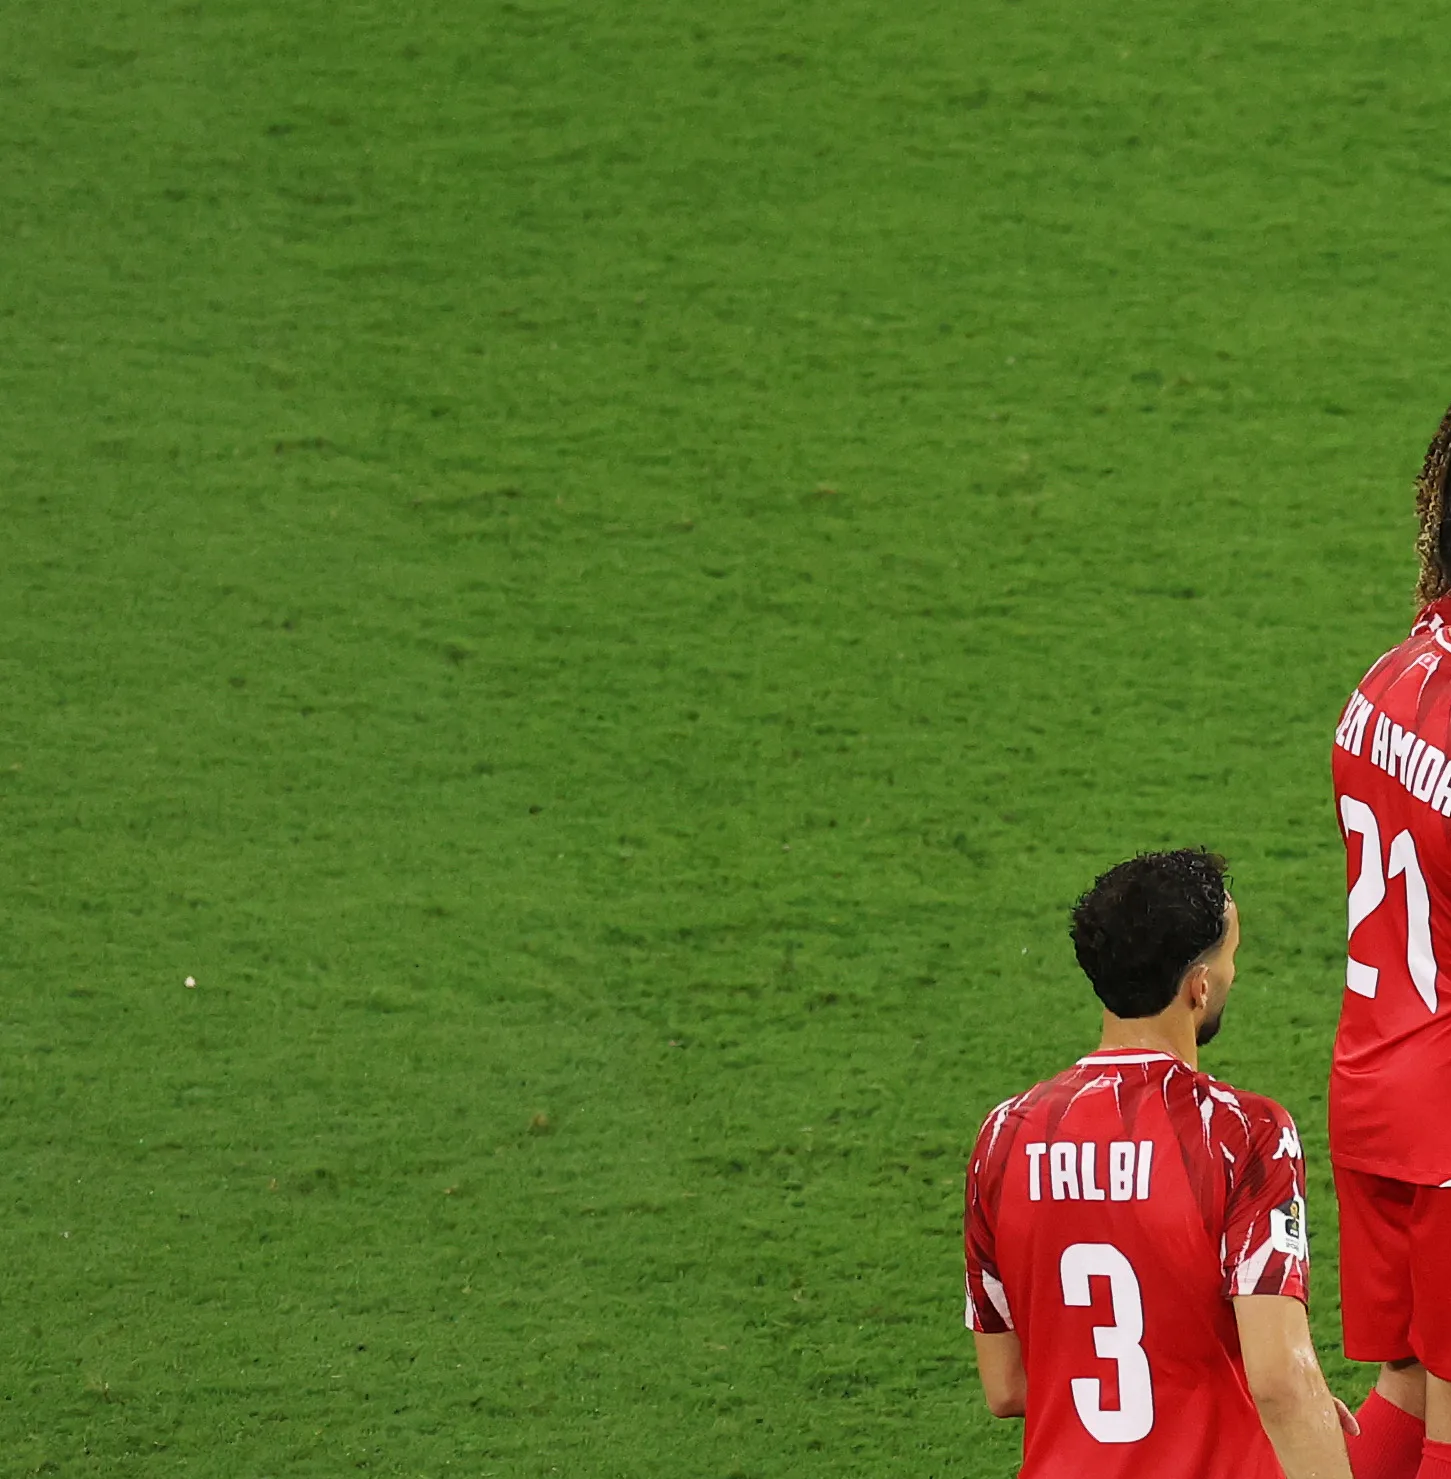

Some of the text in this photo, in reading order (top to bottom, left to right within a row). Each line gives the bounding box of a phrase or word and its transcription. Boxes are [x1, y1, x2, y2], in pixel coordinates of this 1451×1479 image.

[1335, 688, 1375, 757] EN
[1340, 794, 1439, 1015] 21
[1025, 1140, 1154, 1202] TALBI
[1060, 1243, 1155, 1443] 3
